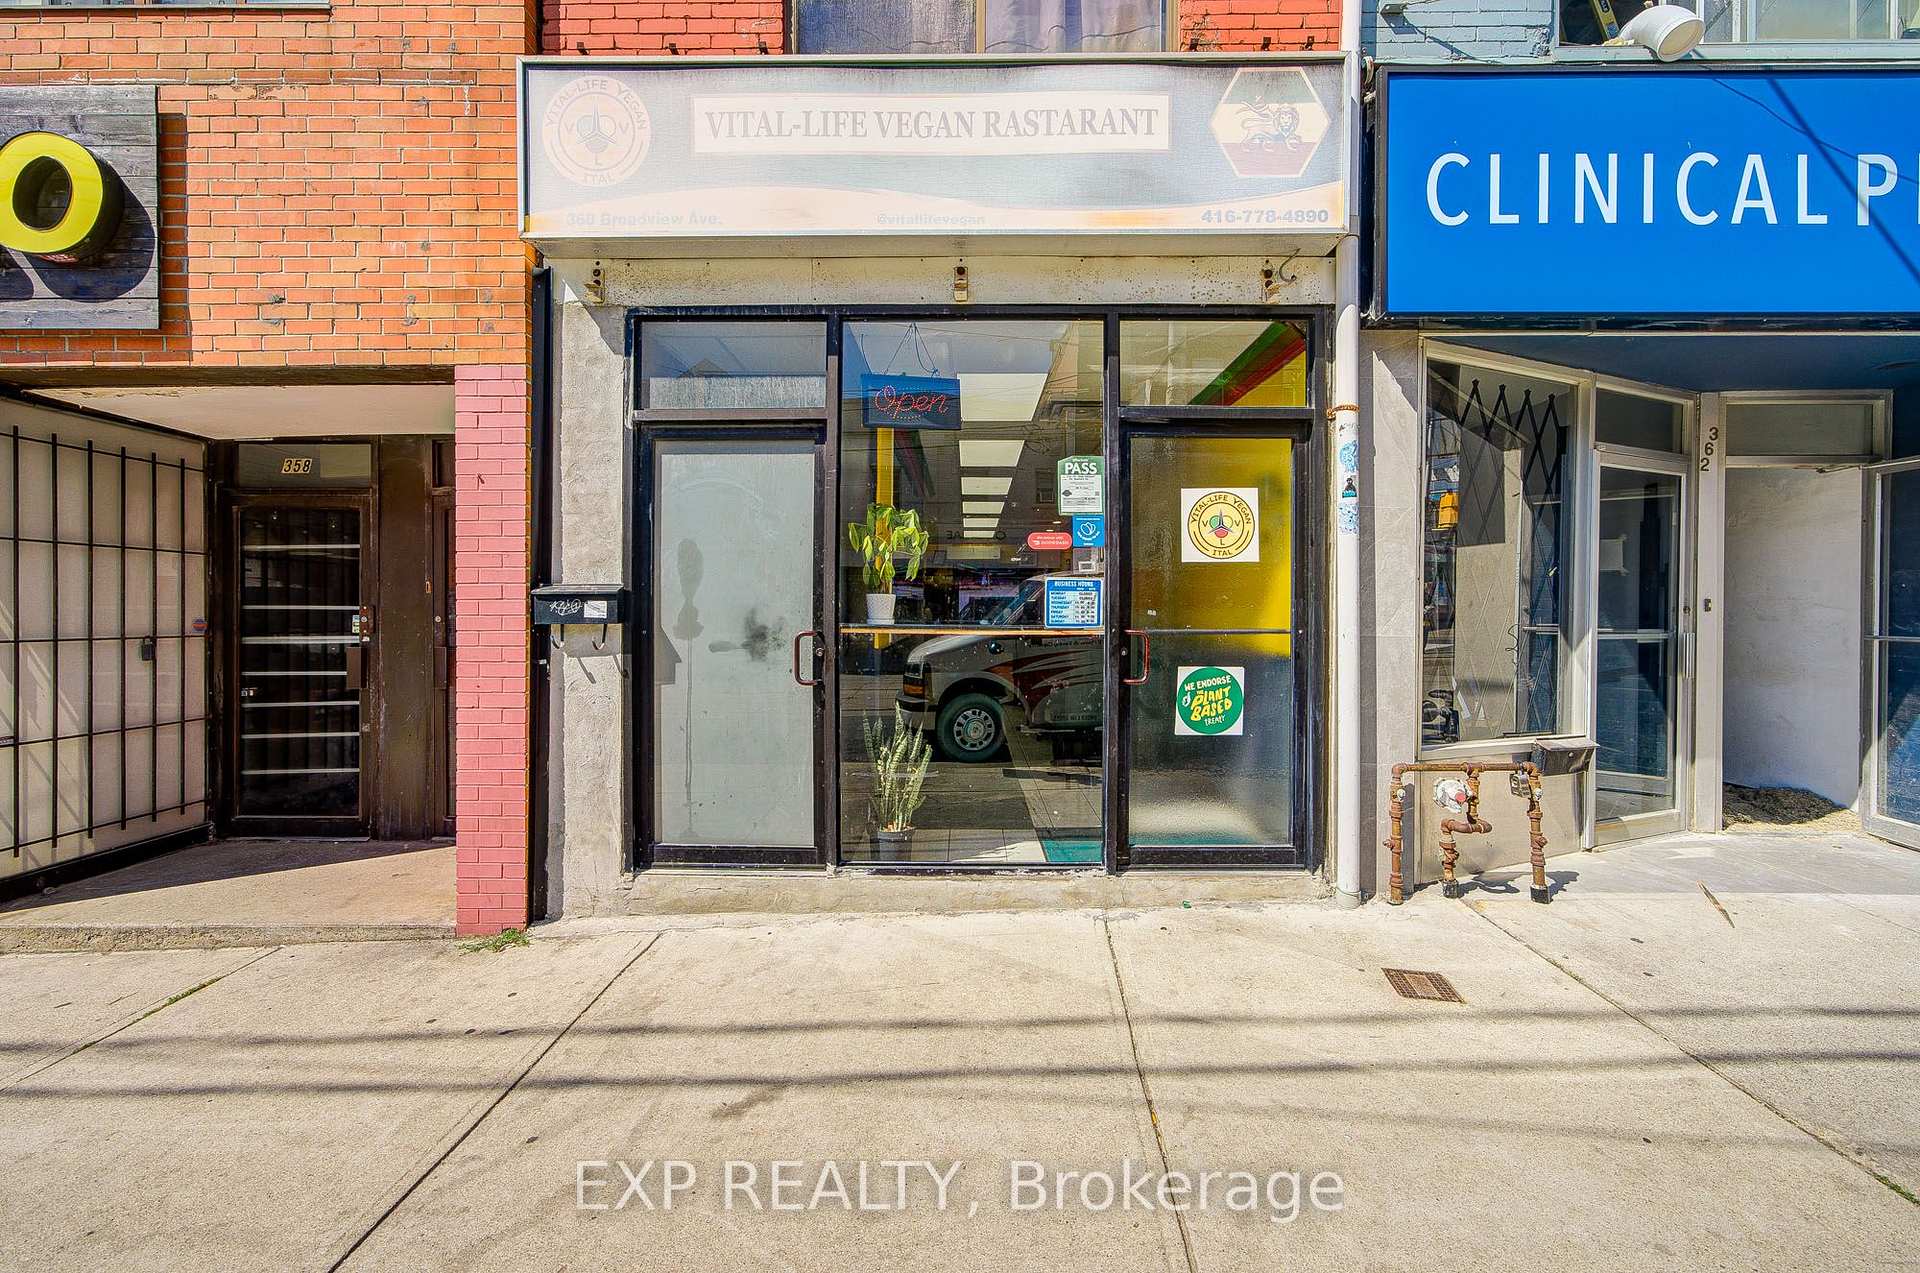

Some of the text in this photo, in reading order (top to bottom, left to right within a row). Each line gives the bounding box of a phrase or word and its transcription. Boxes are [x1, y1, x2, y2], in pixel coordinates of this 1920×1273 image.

[616, 82, 648, 130] VEGAN
[704, 107, 1159, 139] VITAL-LIFE VEGAN RASTARANT
[1201, 209, 1329, 224] 416-778-4890
[874, 385, 949, 419] Open
[283, 459, 311, 473] 358
[1064, 462, 1098, 475] PASS
[1190, 494, 1252, 525] VITAL-LIFE VEGAN
[1184, 675, 1232, 692] WE ENDORSE
[1190, 685, 1232, 710] PLANT
[1190, 697, 1233, 722] BASED
[1204, 714, 1226, 727] TREATY
